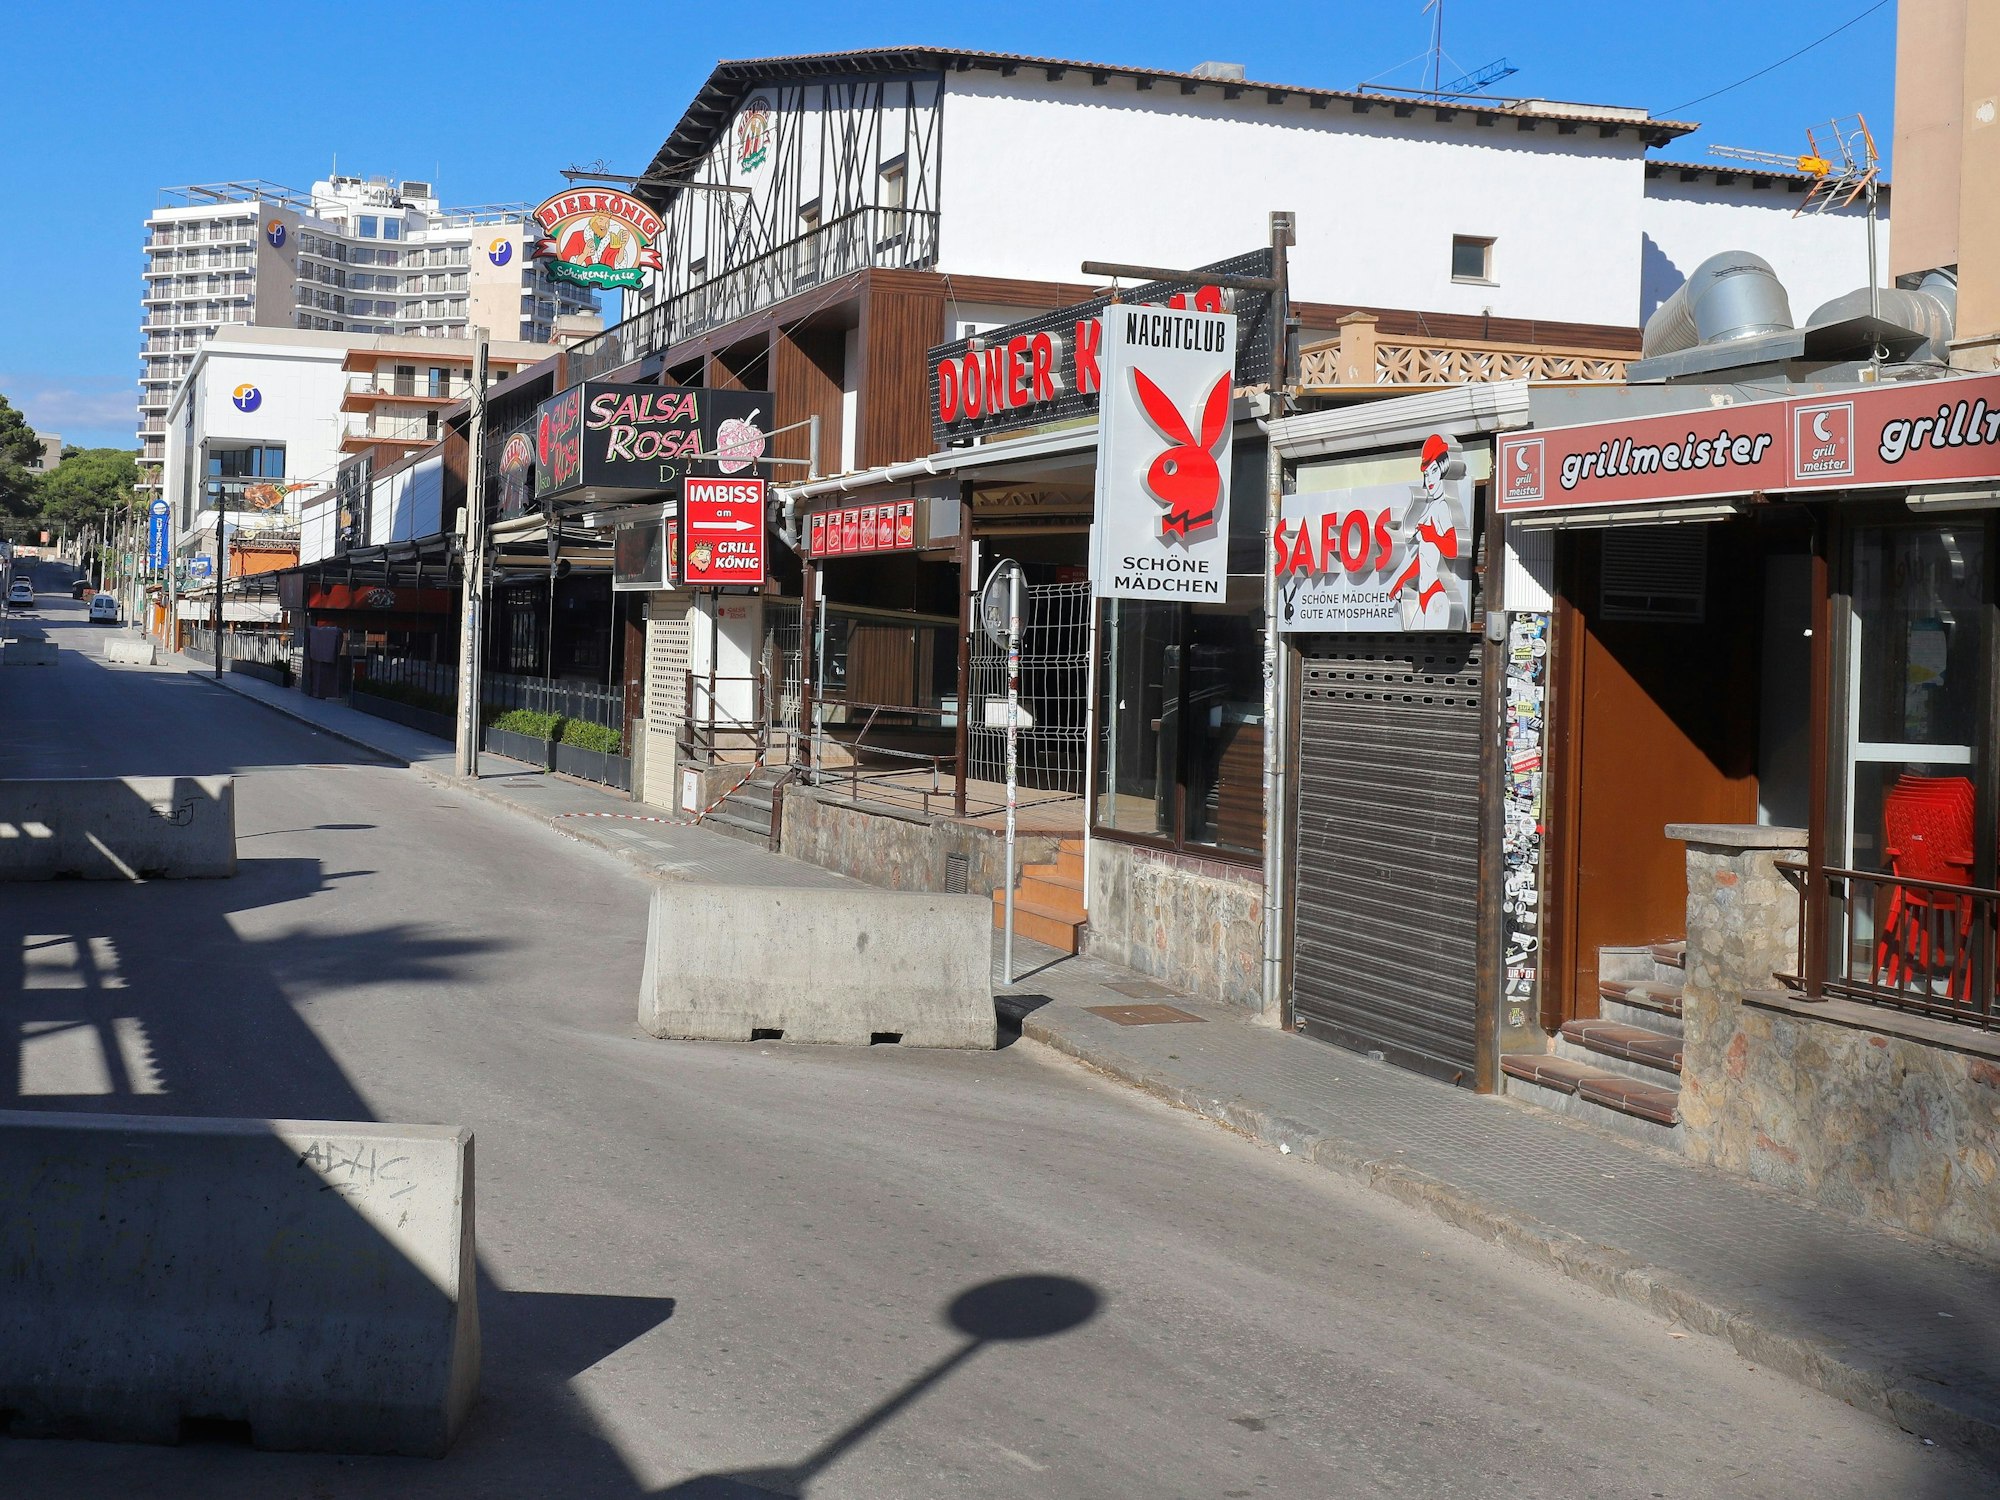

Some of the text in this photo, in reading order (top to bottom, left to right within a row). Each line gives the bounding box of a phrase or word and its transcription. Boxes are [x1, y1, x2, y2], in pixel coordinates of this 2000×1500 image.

[540, 195, 659, 235] BIERKÖNIG
[1126, 312, 1226, 353] NACHTCLUB
[938, 331, 1057, 424] DÖNER
[586, 392, 699, 431] SALSA
[605, 425, 704, 463] ROSA
[1812, 443, 1837, 460] grill
[1560, 429, 1773, 490] grillmeister
[1803, 458, 1846, 472] meister
[1515, 473, 1532, 487] grill
[690, 485, 759, 504] IMBISS
[1509, 486, 1538, 496] meister
[717, 542, 757, 554] GRILL
[1273, 506, 1392, 577] SAFOS
[715, 555, 759, 569] KÖNIG
[1122, 554, 1209, 574] SCHÖNE
[1114, 572, 1218, 594] MÄDCHEN
[1301, 590, 1339, 605] SCHÖNE
[1300, 604, 1394, 619] GUTE ATMOSPHÄRE
